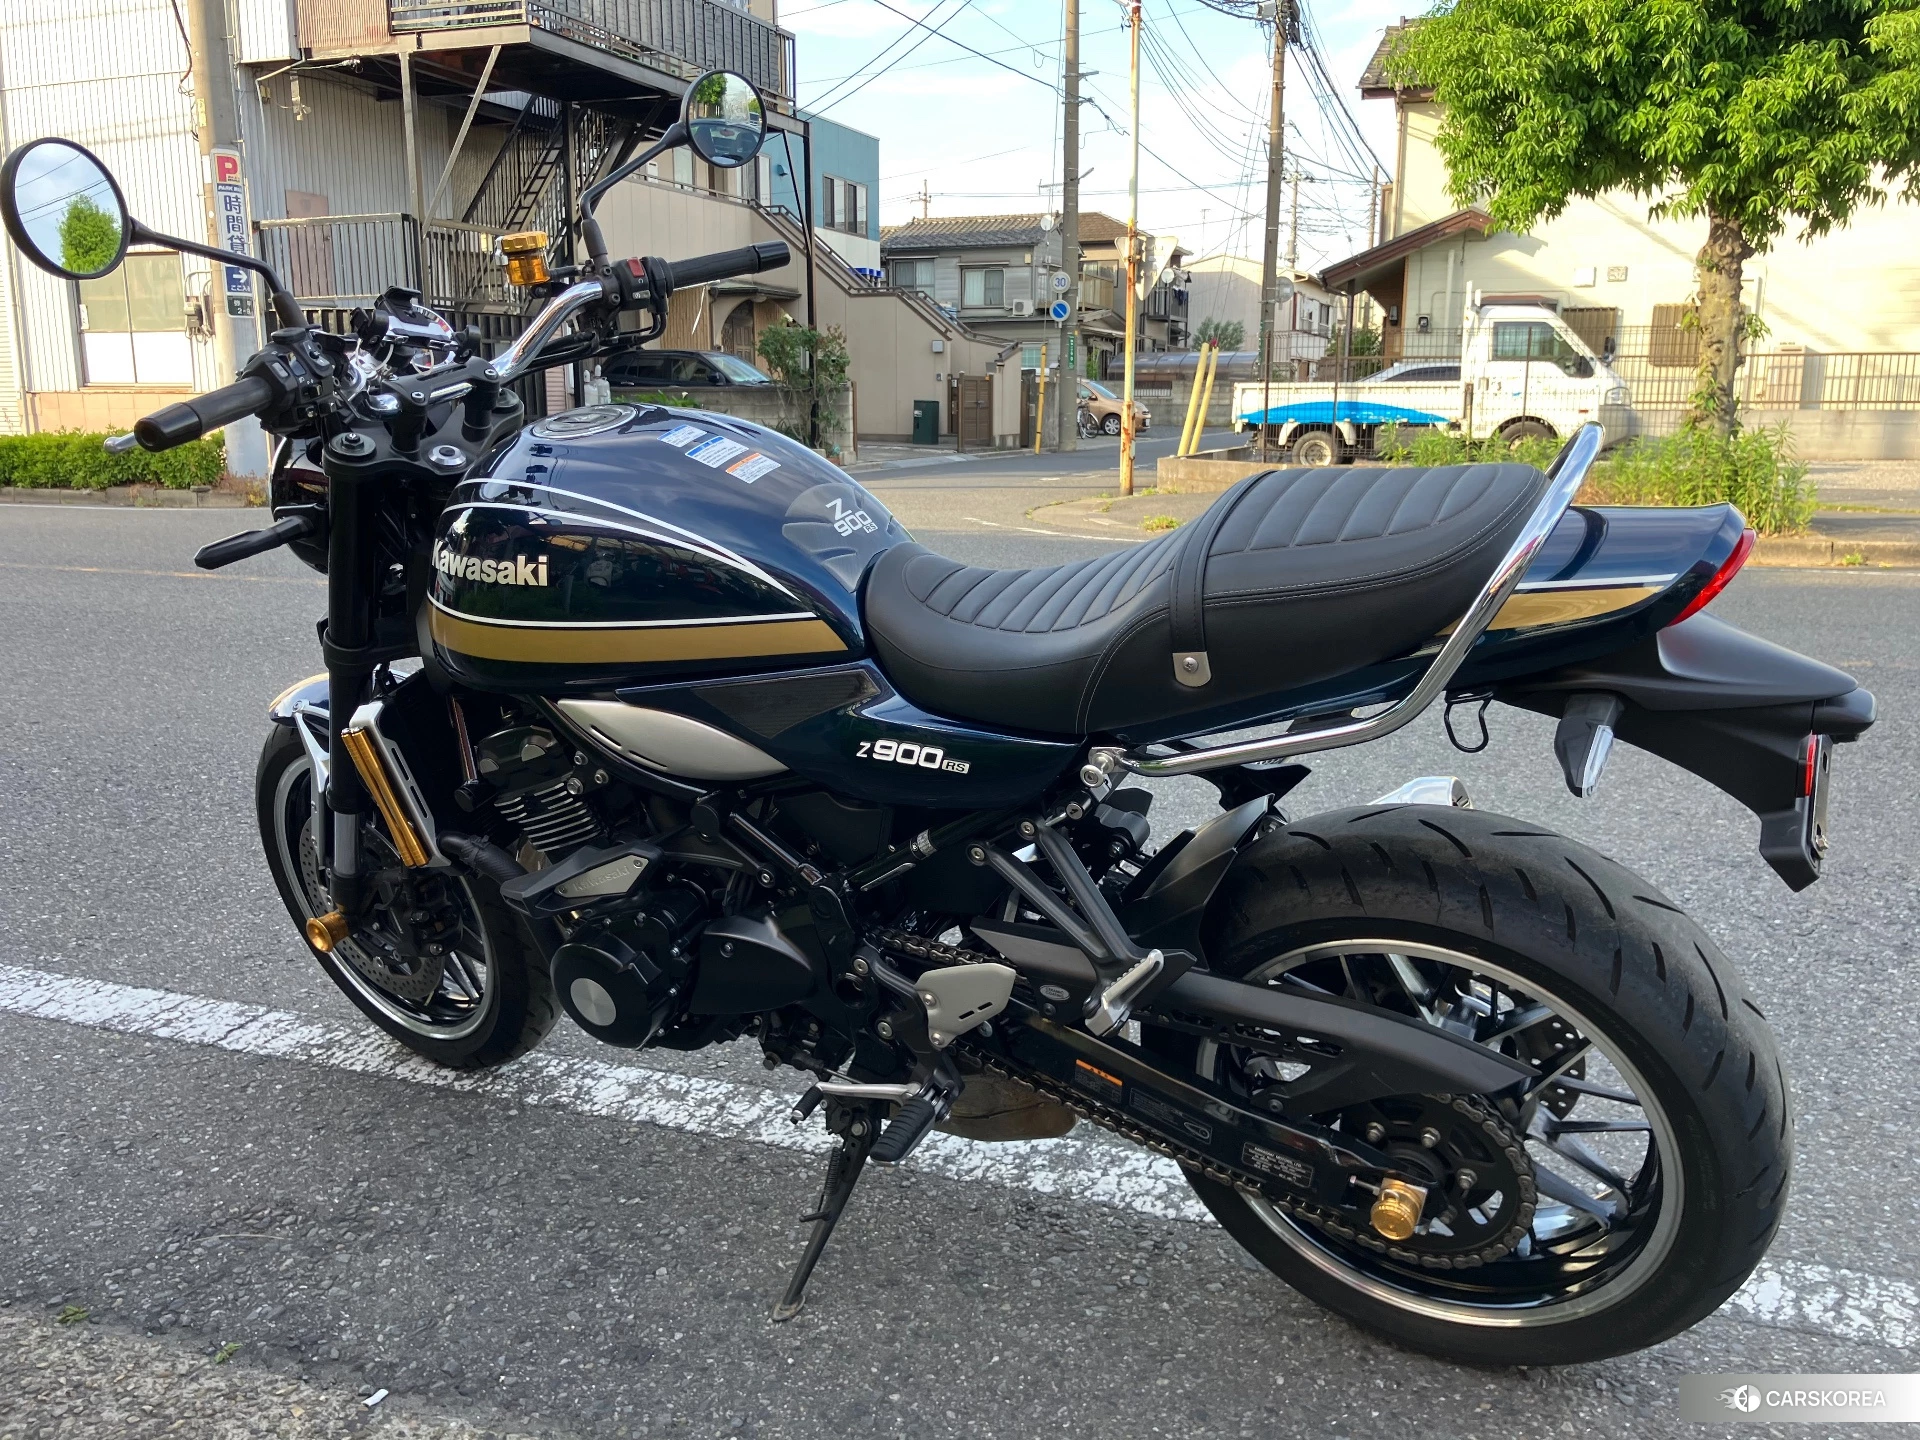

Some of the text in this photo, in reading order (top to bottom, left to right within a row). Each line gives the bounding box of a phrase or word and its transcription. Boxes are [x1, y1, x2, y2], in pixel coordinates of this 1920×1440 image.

[216, 155, 239, 182] P
[1054, 277, 1067, 288] 30
[431, 538, 549, 587] Kawasaki
